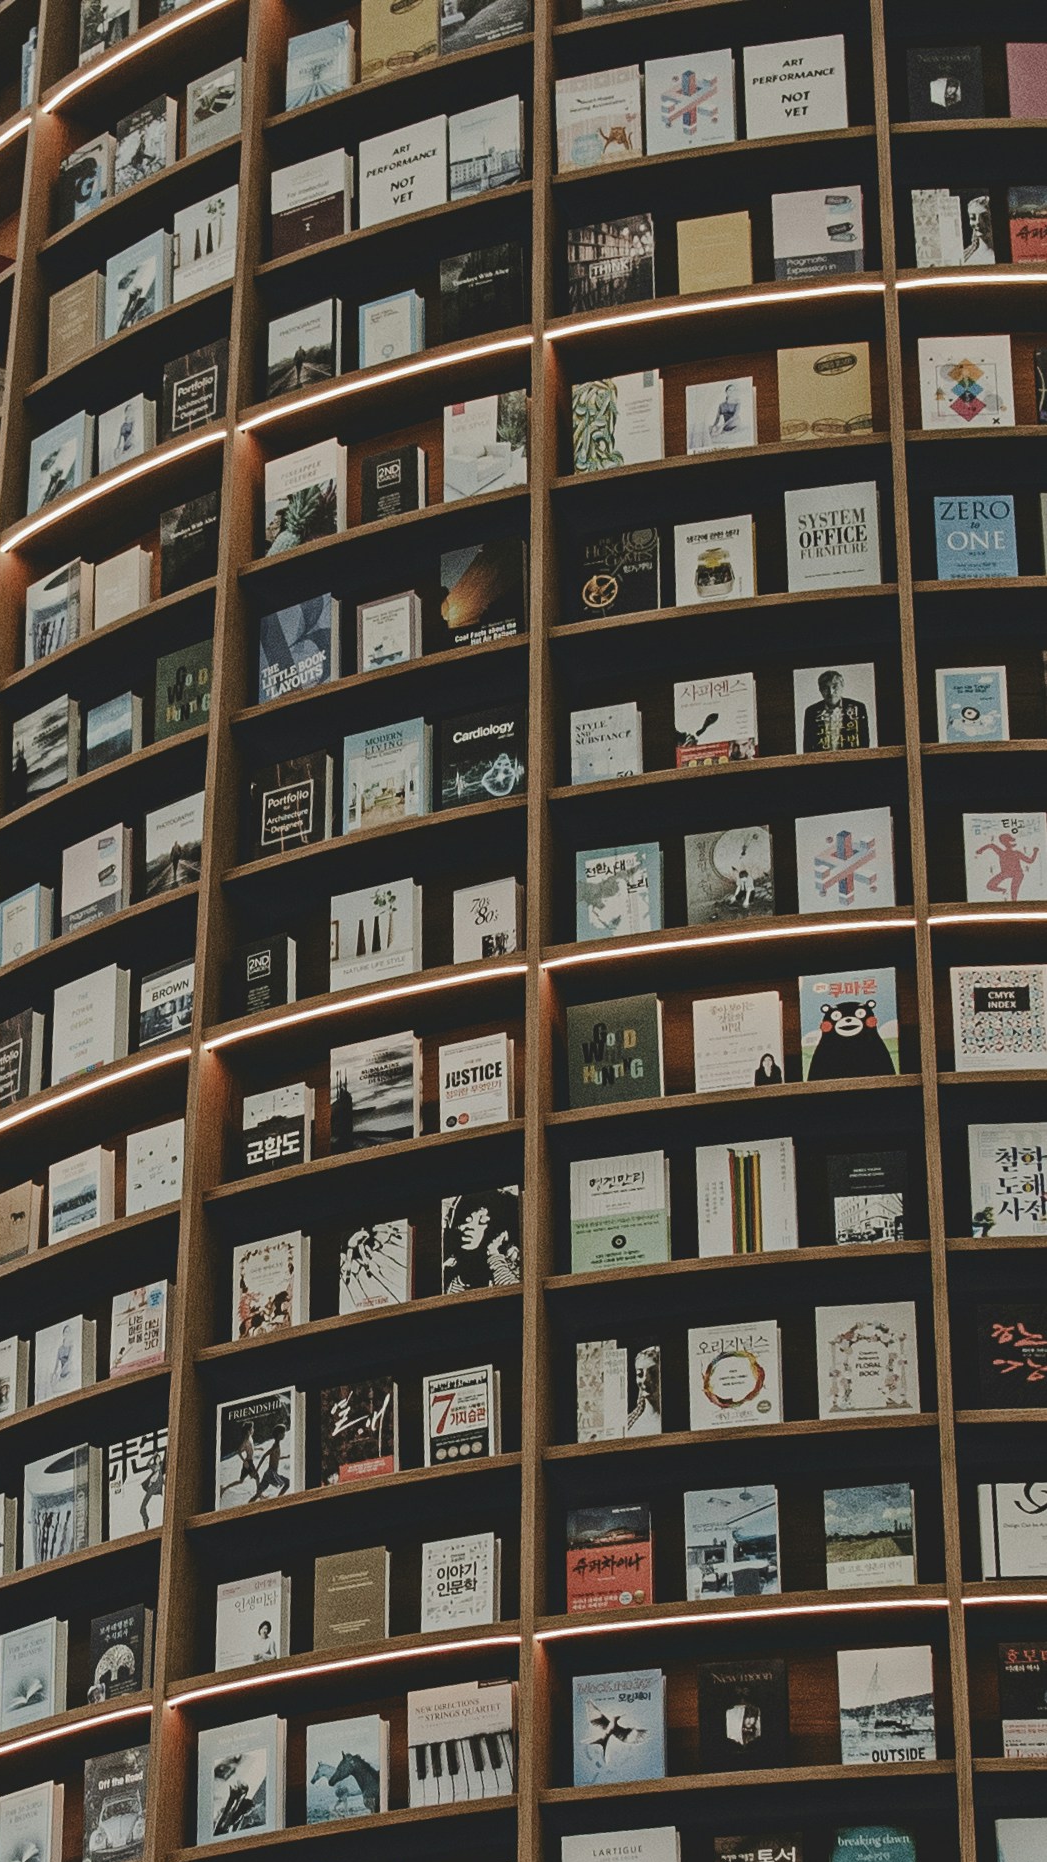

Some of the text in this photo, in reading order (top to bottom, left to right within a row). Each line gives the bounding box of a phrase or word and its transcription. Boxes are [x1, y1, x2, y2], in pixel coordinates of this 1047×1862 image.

[781, 57, 804, 68] ART
[752, 67, 835, 85] PERFORMANCE
[781, 90, 811, 104] NOT
[392, 144, 411, 156] ART
[365, 148, 438, 178] PERFORMANCE
[390, 175, 416, 192] NOT
[377, 463, 400, 477] 2ND
[798, 508, 866, 531] SYSTEM
[939, 500, 1011, 522] ZERO
[970, 522, 980, 530] to
[799, 525, 868, 548] OFFICE
[946, 530, 1005, 550] ONE
[800, 542, 868, 560] FURNITURE
[298, 649, 326, 672] BOOK
[261, 663, 280, 678] THE
[270, 666, 324, 698] LAYOUTS
[679, 679, 748, 703] 사피엔스
[365, 730, 403, 747] MODERN
[452, 720, 514, 744] Cardiology
[365, 740, 404, 756] LIVING
[267, 789, 310, 809] Portfolio
[266, 807, 309, 825] Architecture
[151, 978, 190, 1003] BROWN
[987, 1000, 1017, 1010] INDEX
[444, 1061, 503, 1089] JUSTICE
[246, 1130, 300, 1165] 군함도
[431, 1392, 454, 1434] 7
[436, 1562, 478, 1580] 이야기
[436, 1580, 478, 1598] 인문학
[415, 1698, 480, 1715] NEW DIRECTIONS
[424, 1702, 501, 1722] STRINGS QUARTET
[871, 1748, 926, 1763] OUTSIDE
[837, 1834, 909, 1847] breaking dawn
